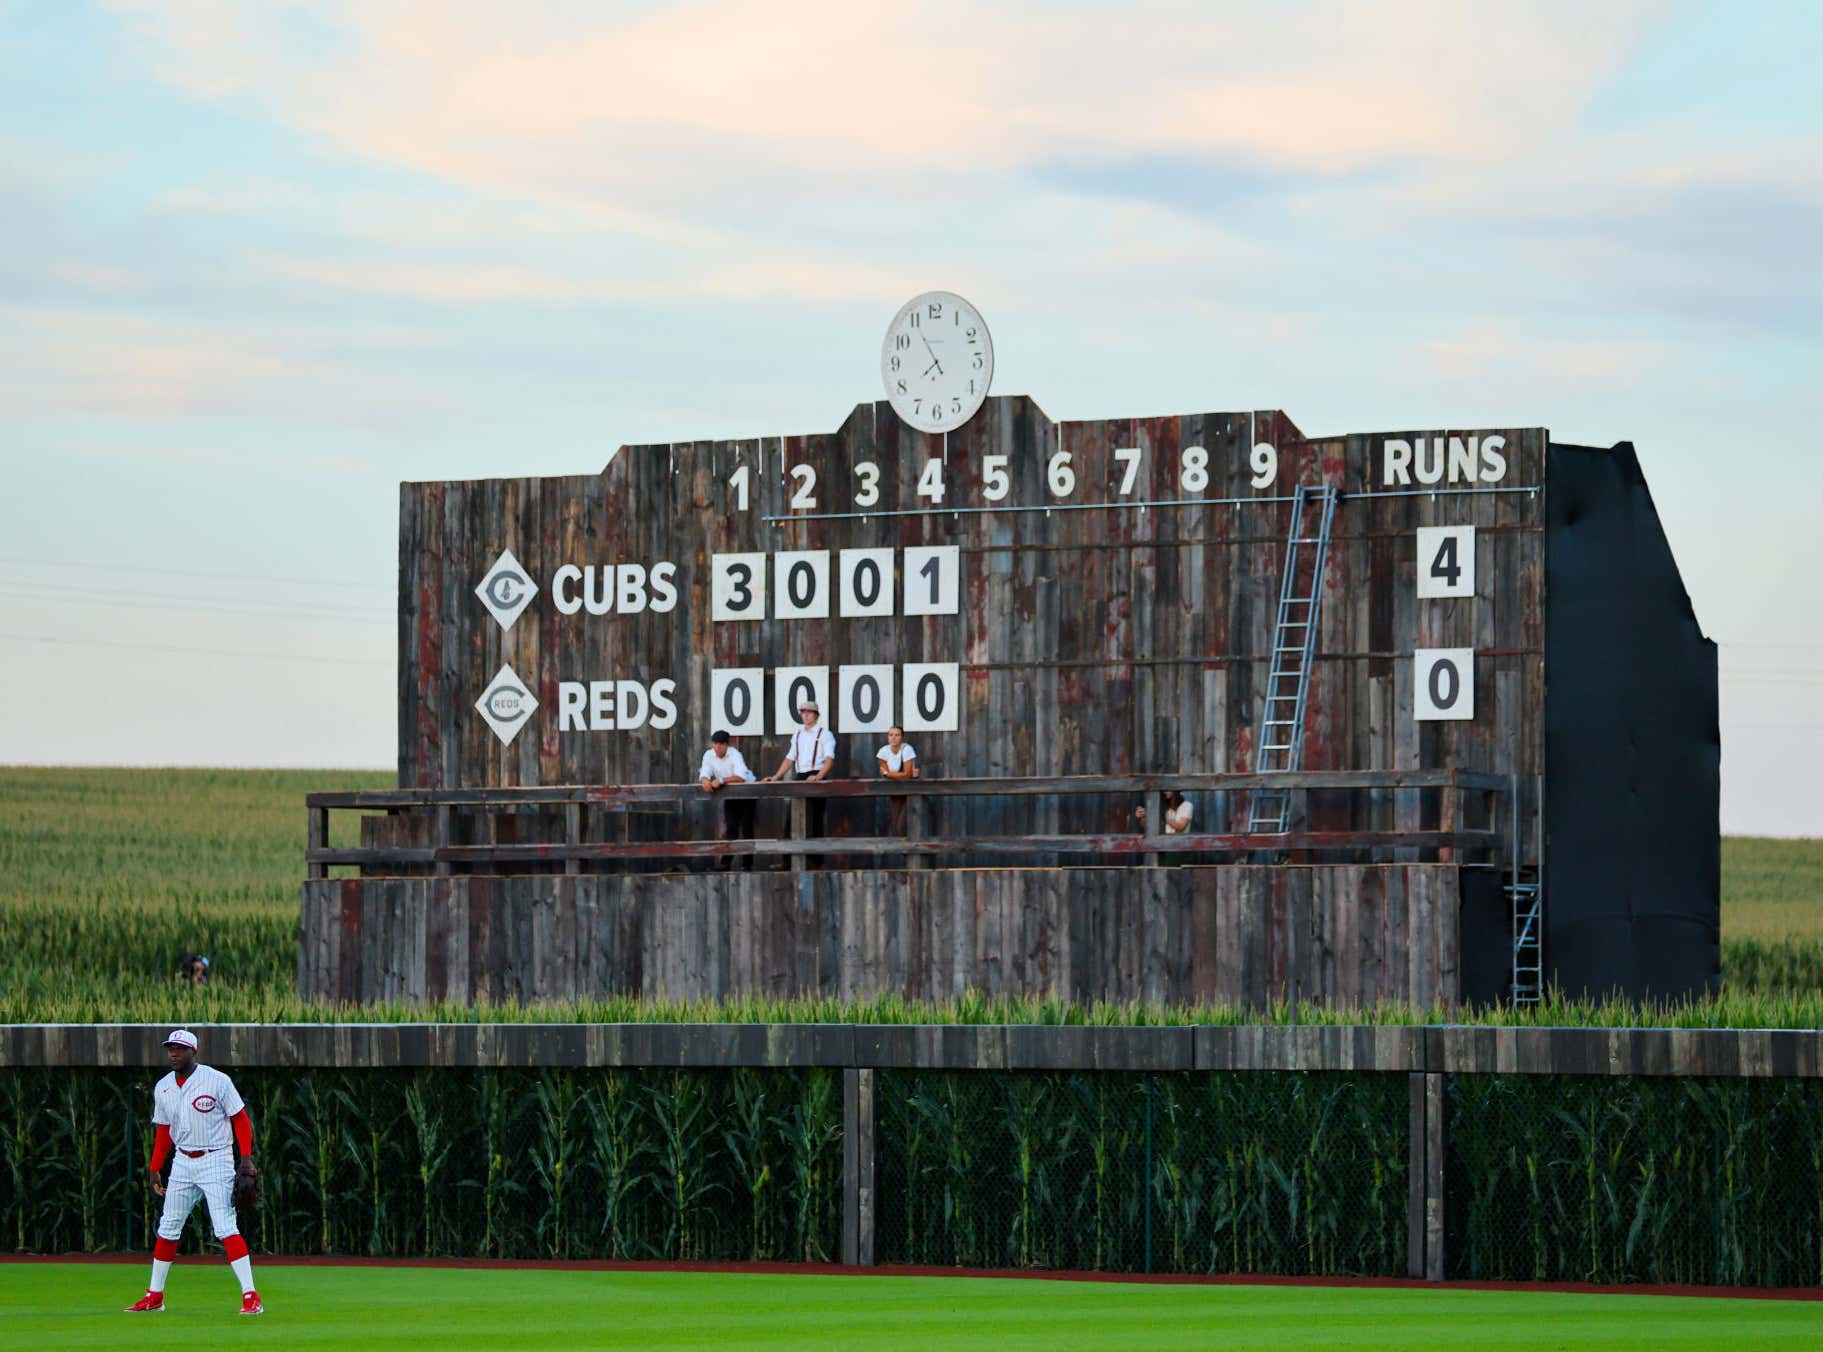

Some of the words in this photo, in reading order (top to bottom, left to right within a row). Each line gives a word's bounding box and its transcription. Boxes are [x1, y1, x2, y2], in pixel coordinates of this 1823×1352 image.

[928, 303, 942, 320] 12
[910, 313, 920, 328] 11
[896, 334, 910, 351] 10
[966, 328, 977, 344] 2
[890, 355, 900, 371] 9
[897, 379, 907, 394] 8
[914, 398, 923, 415] 7
[932, 404, 942, 421] 6
[952, 397, 961, 414] 5
[729, 465, 749, 511] 1
[790, 464, 817, 509] 2
[854, 461, 880, 507] 3
[917, 457, 946, 504] 4
[982, 454, 1010, 501] 5
[1048, 451, 1076, 497] 6
[1114, 448, 1142, 495] 7
[1180, 446, 1209, 493] 8
[1249, 442, 1278, 489] 9
[1383, 436, 1507, 485] RUNS
[552, 561, 678, 616] CUBS
[725, 562, 753, 612] 3
[787, 560, 817, 609] 0
[852, 557, 881, 608] 0
[919, 555, 941, 605] 1
[1430, 536, 1462, 587] 4
[558, 678, 678, 732] REDS
[724, 677, 752, 727] 0
[788, 675, 817, 725] 0
[851, 674, 881, 724] 0
[916, 672, 946, 722] 0
[1428, 658, 1461, 710] 0
[494, 699, 520, 709] REDS
